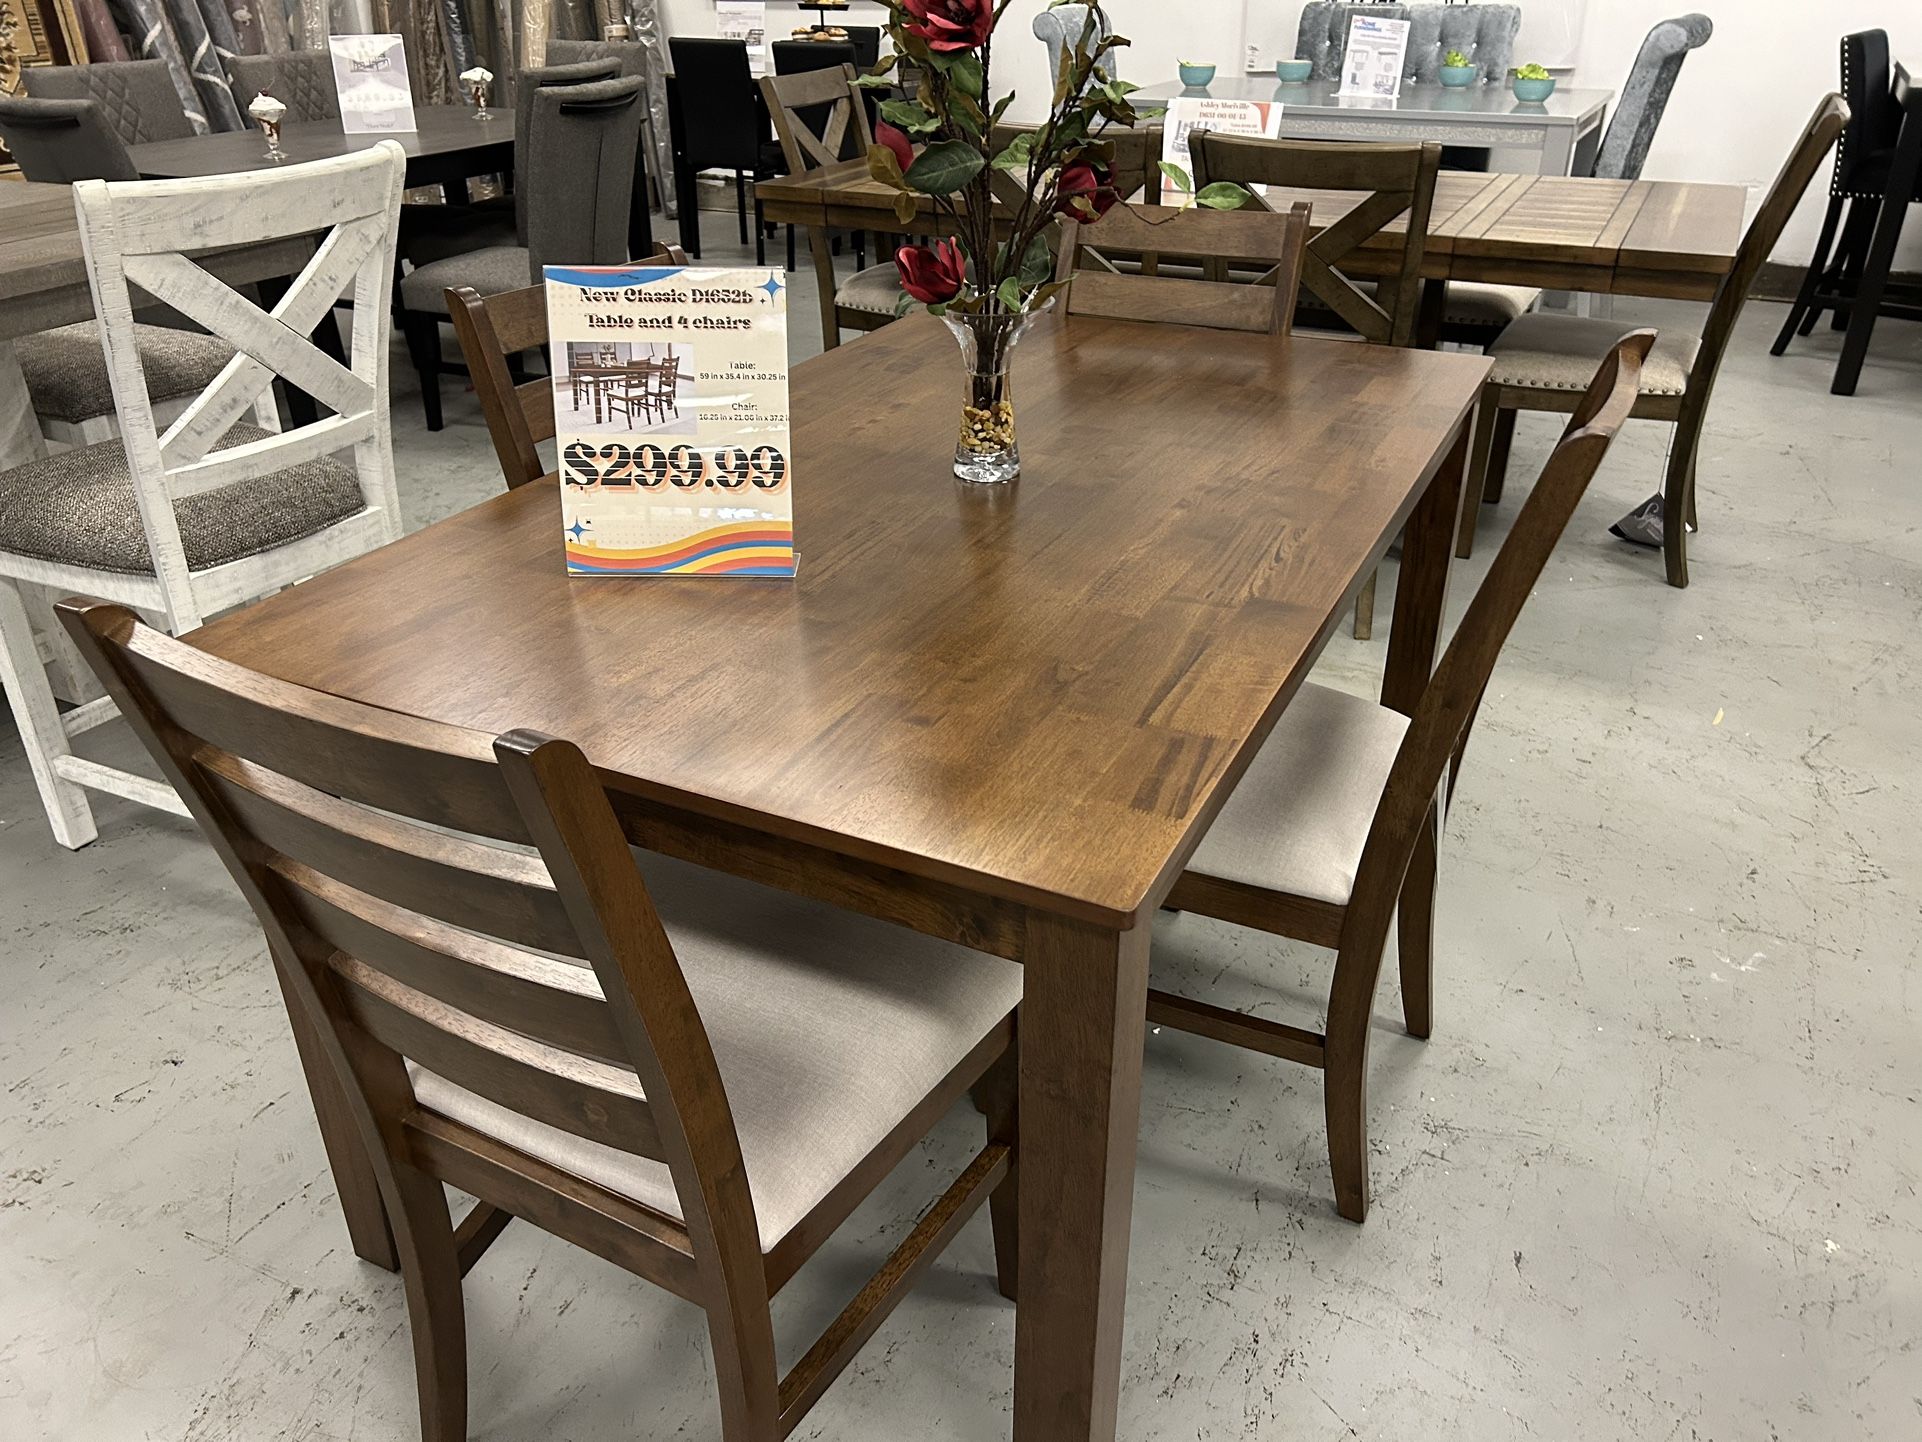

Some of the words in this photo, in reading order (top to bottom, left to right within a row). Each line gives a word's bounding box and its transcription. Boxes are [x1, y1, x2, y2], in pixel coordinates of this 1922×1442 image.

[579, 287, 619, 302] New
[624, 288, 688, 303] Classic
[691, 288, 754, 304] D1652b
[584, 312, 634, 328] Table
[638, 315, 673, 329] and
[677, 315, 689, 329] 4
[692, 315, 752, 330] chairs
[729, 361, 756, 370] Table:
[699, 372, 710, 380] 59
[757, 373, 778, 381] 30.25
[779, 373, 786, 381] in
[731, 402, 758, 411] Chair:
[769, 414, 785, 422] 37.2
[563, 438, 786, 492] $299.99
